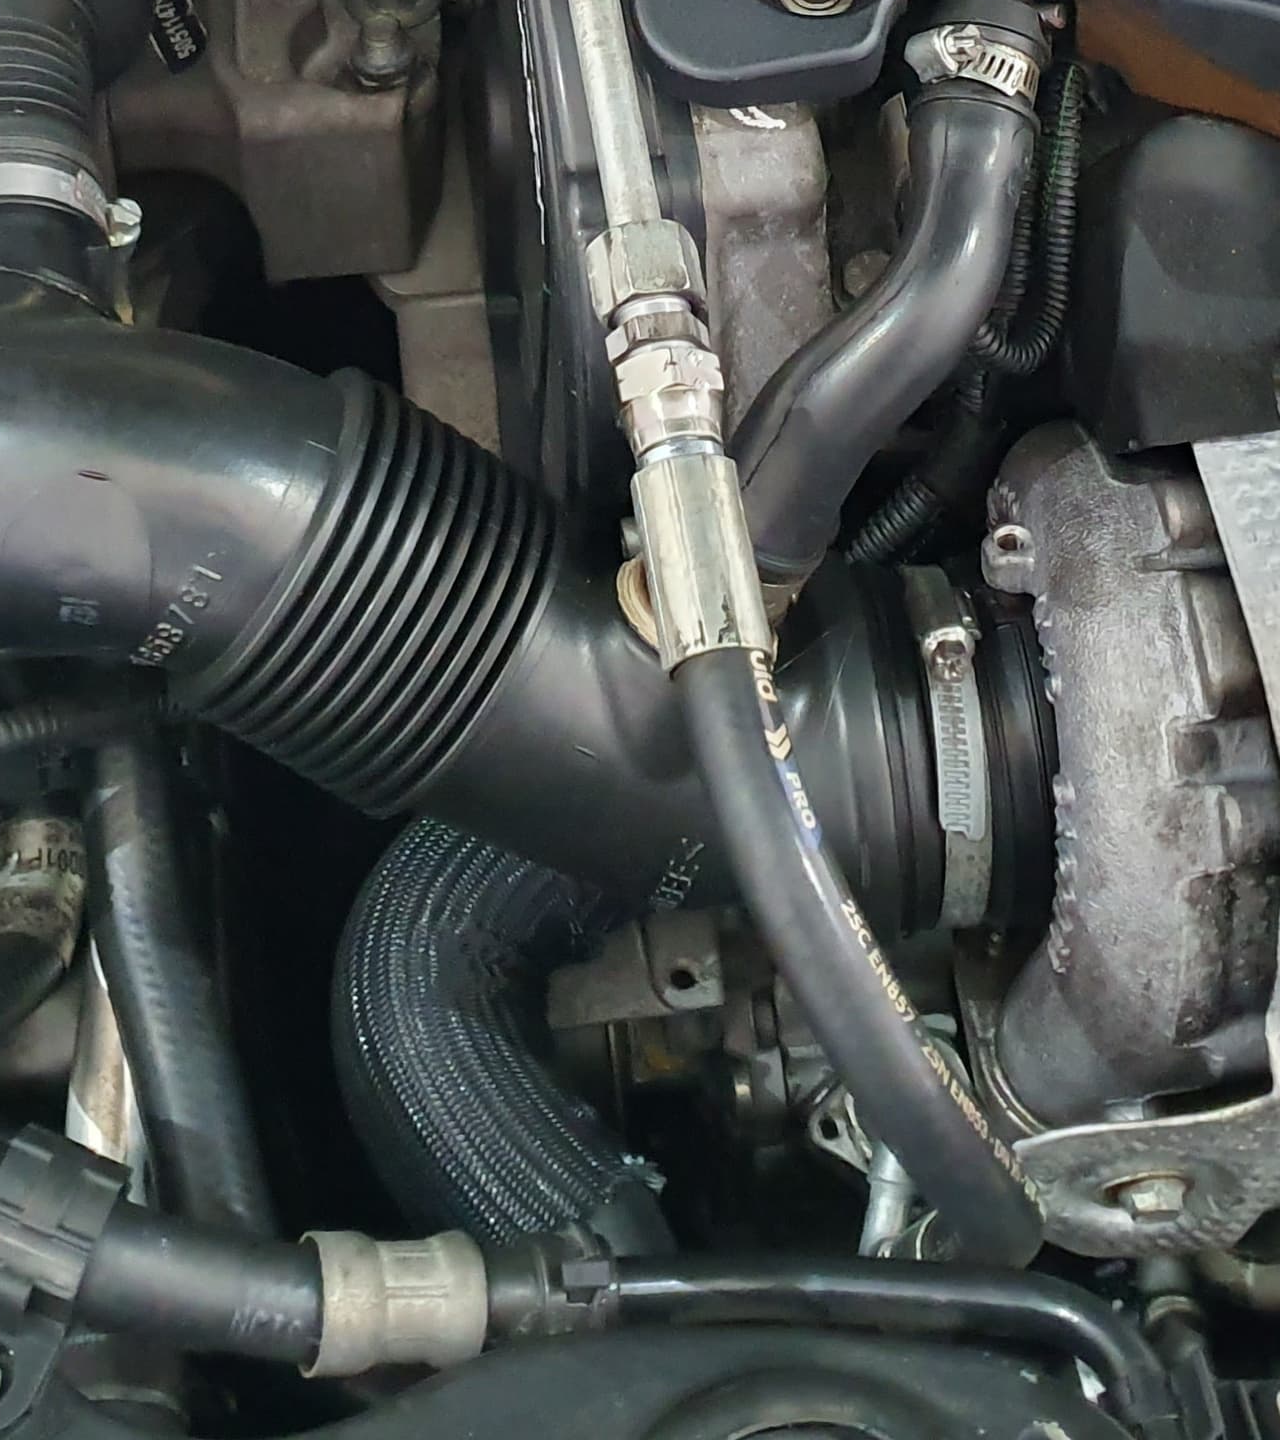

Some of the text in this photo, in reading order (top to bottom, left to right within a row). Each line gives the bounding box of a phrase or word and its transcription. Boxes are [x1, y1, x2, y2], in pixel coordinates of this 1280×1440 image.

[786, 771, 816, 829] PRO
[841, 899, 871, 949] 2SC
[868, 948, 915, 1022] EN857
